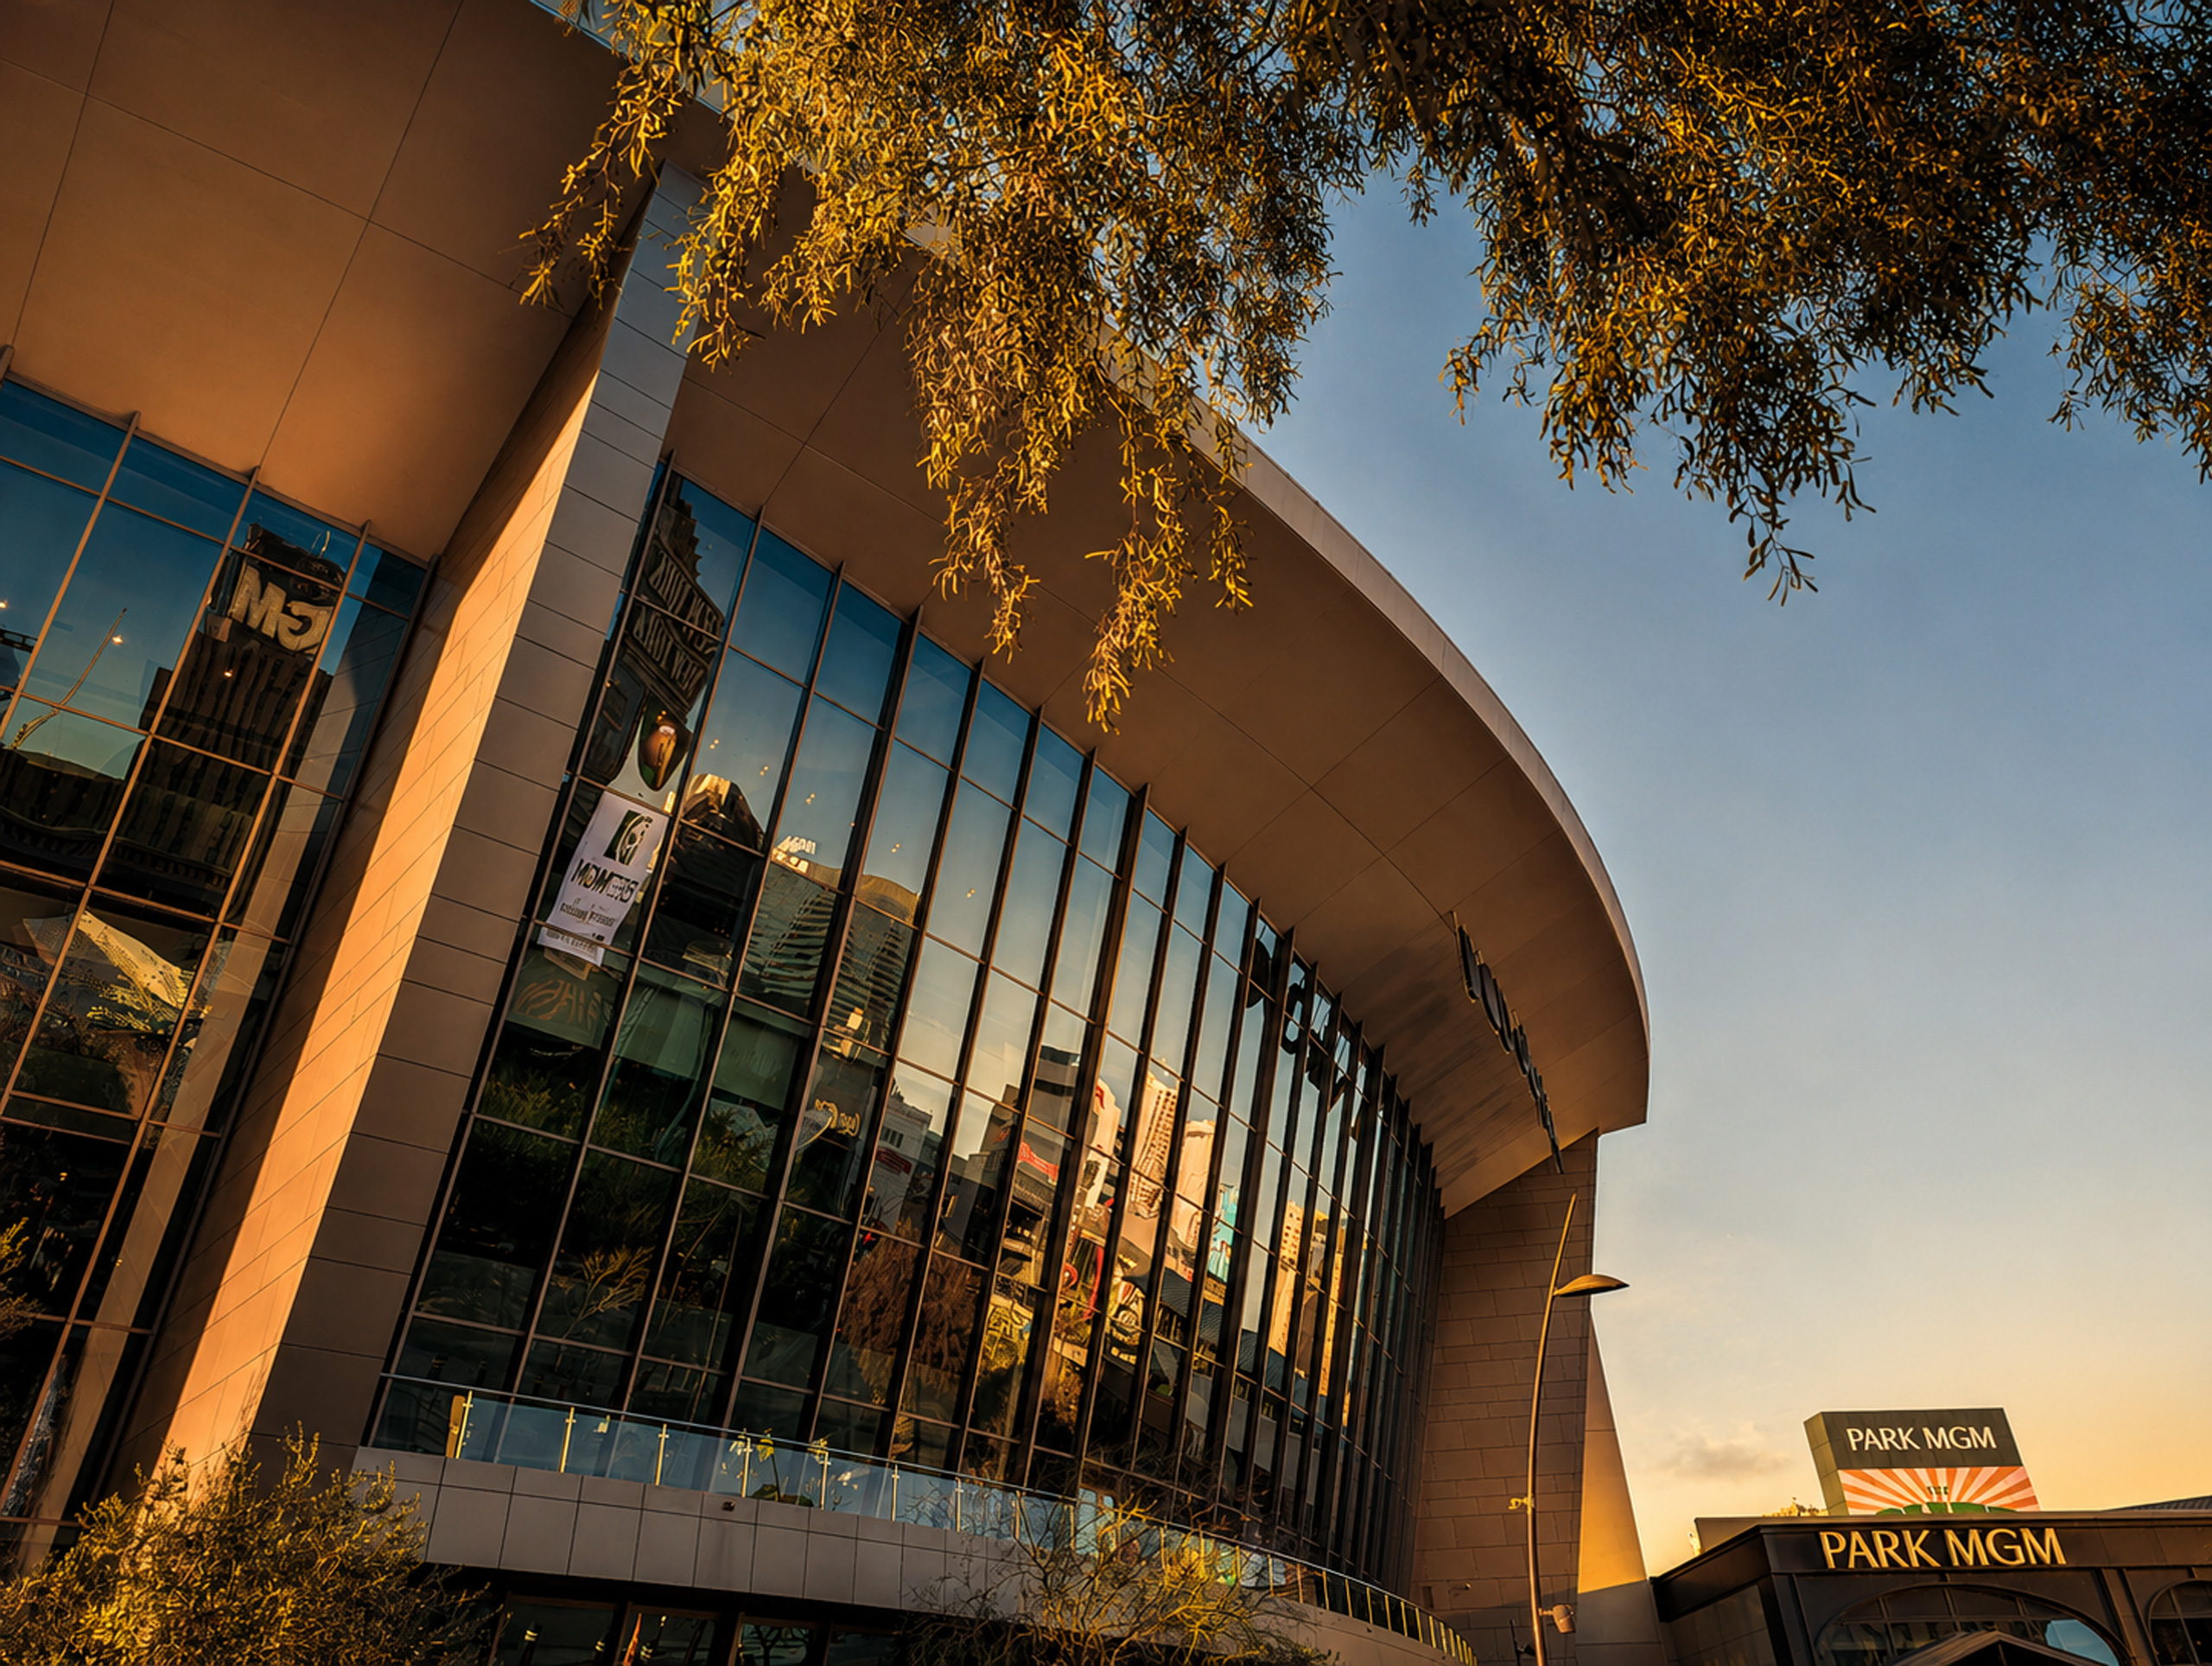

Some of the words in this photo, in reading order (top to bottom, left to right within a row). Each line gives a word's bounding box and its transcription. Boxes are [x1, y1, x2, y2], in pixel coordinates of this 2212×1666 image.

[1846, 1427, 1921, 1452] PARK
[1923, 1426, 1998, 1450] MGM
[1819, 1529, 1942, 1569] PARK
[1944, 1528, 2067, 1567] MGM
